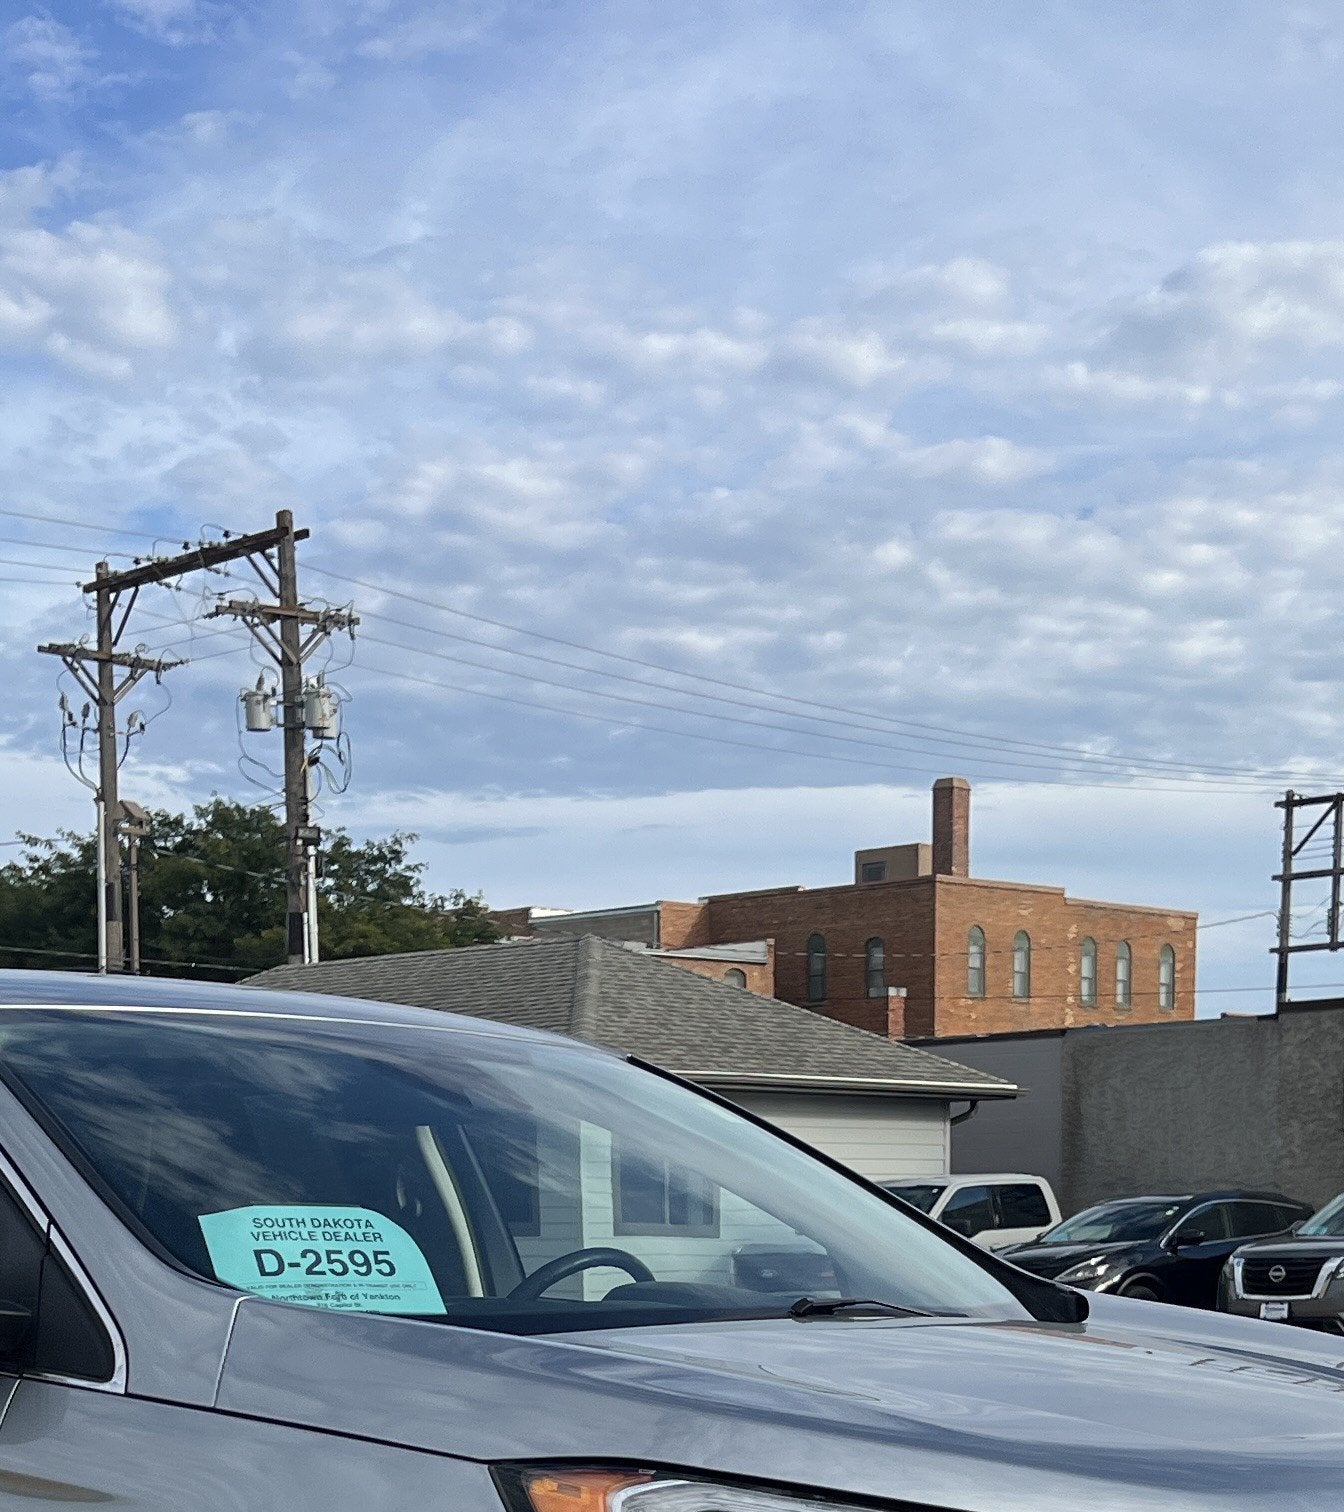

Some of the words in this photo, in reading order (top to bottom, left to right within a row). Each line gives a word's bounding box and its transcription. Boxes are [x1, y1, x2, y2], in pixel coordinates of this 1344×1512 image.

[252, 1217, 306, 1230] SOUTH
[311, 1218, 375, 1230] DAKOTA
[250, 1231, 319, 1242] VEHICLE
[322, 1231, 384, 1243] DEALER
[253, 1248, 397, 1278] D-2595
